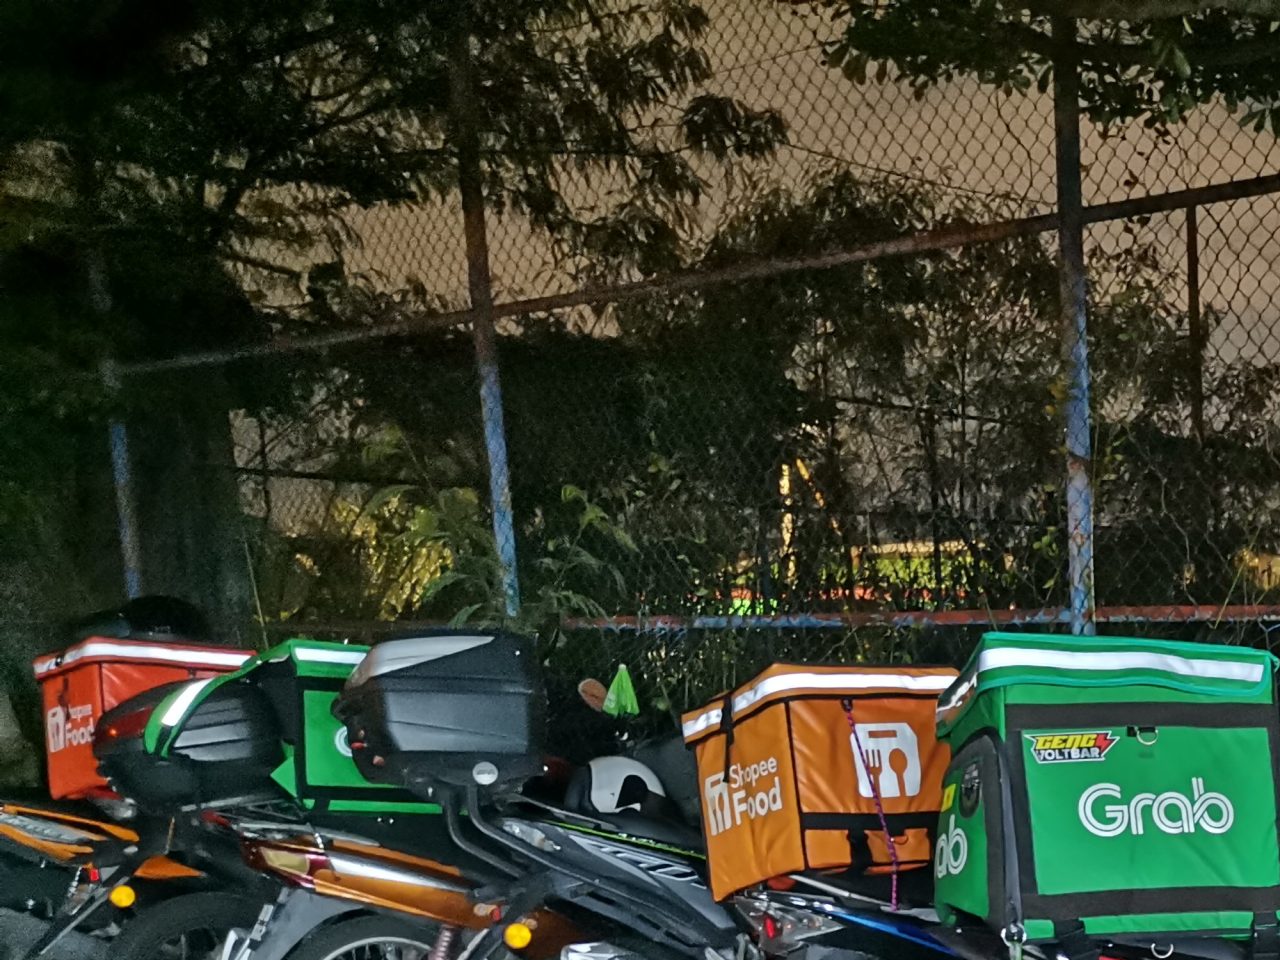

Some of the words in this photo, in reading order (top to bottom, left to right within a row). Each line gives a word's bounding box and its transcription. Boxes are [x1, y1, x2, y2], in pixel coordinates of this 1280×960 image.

[1035, 734, 1098, 750] GENG
[729, 757, 777, 788] Shopee
[733, 776, 783, 826] Food
[1078, 777, 1234, 837] Grab
